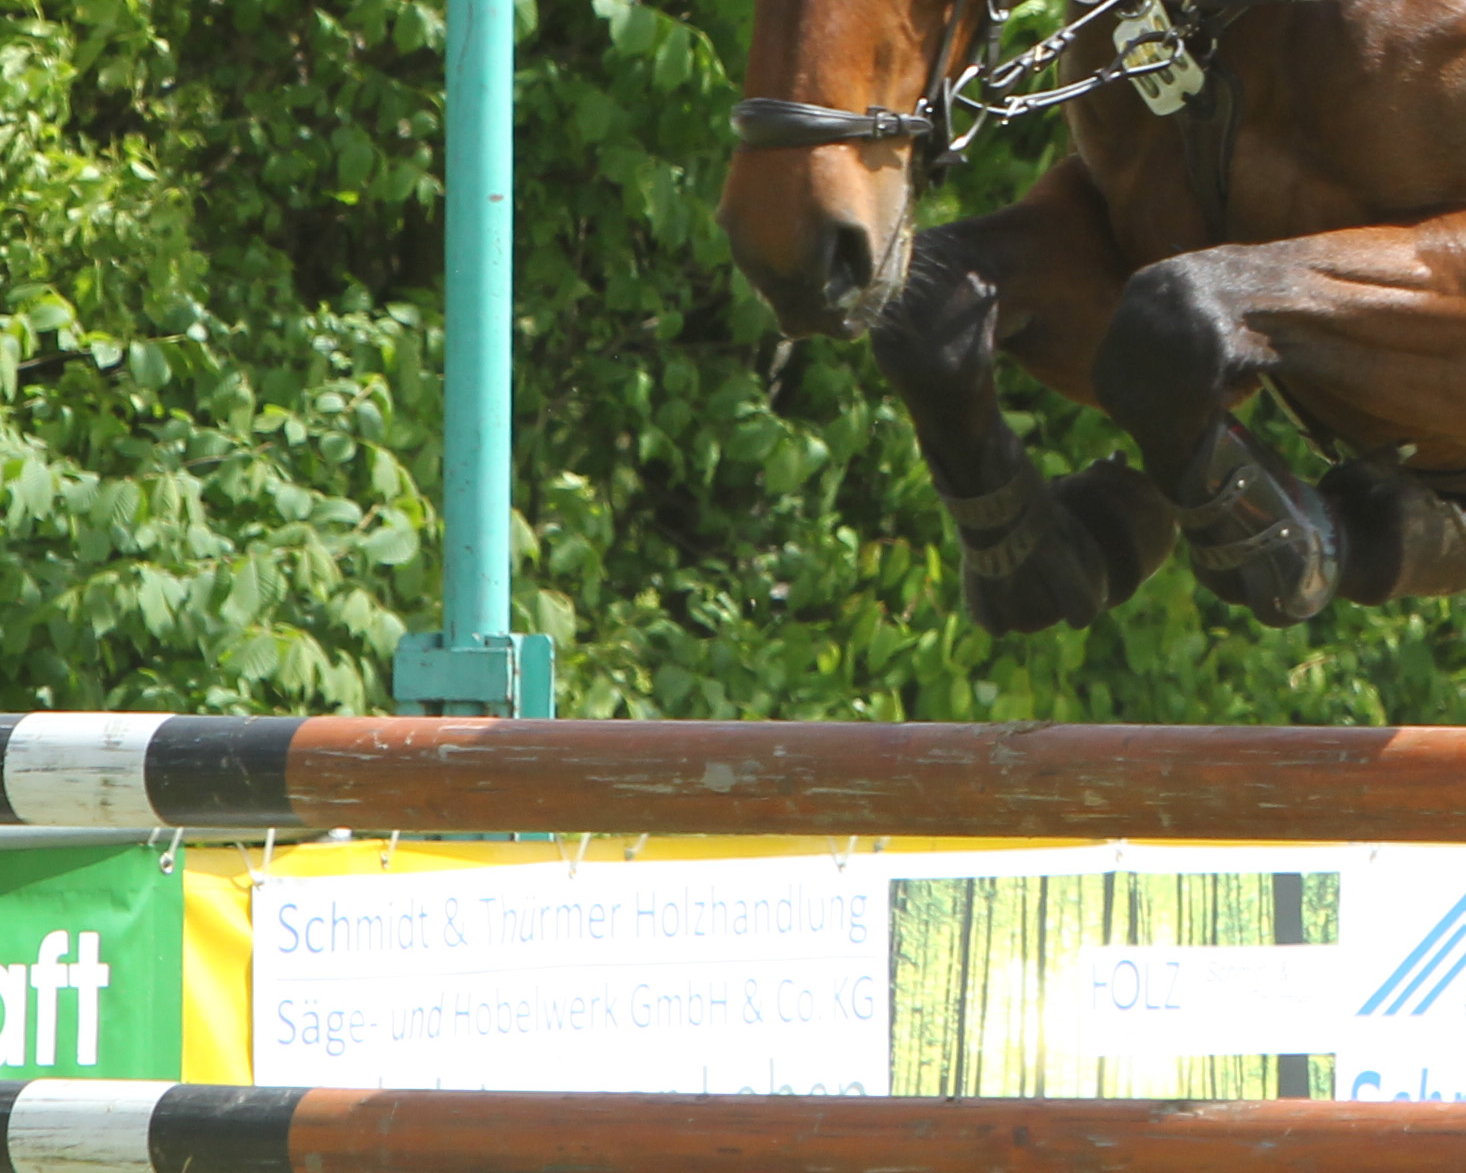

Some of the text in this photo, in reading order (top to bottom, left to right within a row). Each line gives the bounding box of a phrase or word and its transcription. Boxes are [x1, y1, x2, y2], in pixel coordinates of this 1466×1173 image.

[277, 883, 869, 954] Schmidt & Thürmer Holzhandlung
[277, 975, 876, 1057] Säge- und Hobelwerk GmbH & Co. KG
[1091, 958, 1182, 1012] HOLZ
